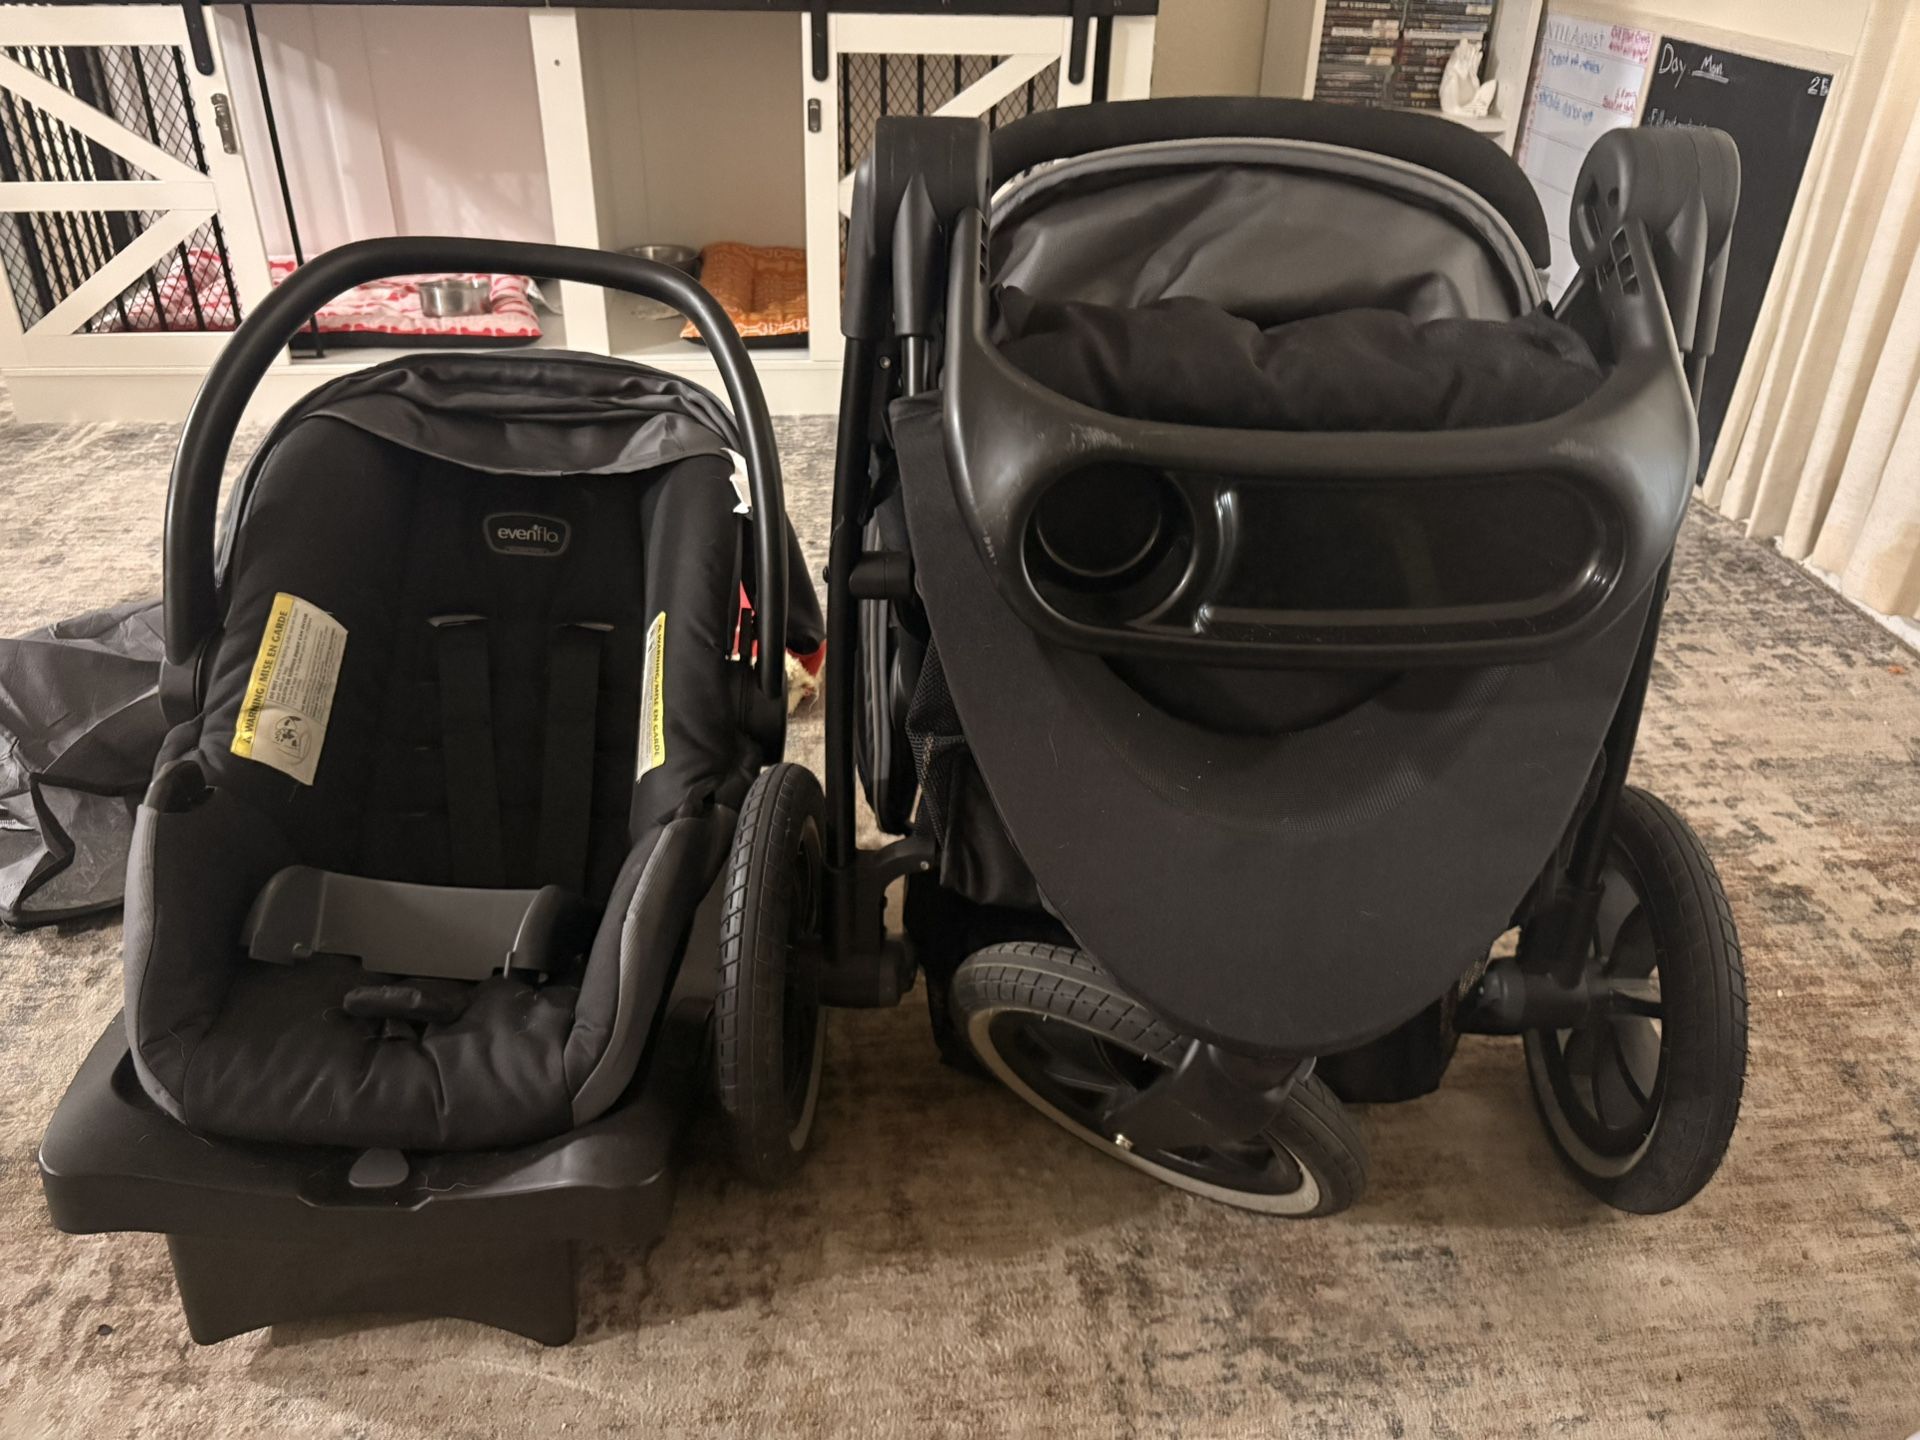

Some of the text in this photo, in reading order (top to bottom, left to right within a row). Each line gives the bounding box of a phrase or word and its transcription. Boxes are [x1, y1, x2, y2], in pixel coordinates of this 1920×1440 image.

[1658, 43, 1686, 89] Day
[497, 524, 559, 543] evenflo
[271, 609, 288, 643] GARDE
[266, 644, 277, 657] EN
[259, 659, 273, 682] MISE
[245, 687, 265, 732] WARNING
